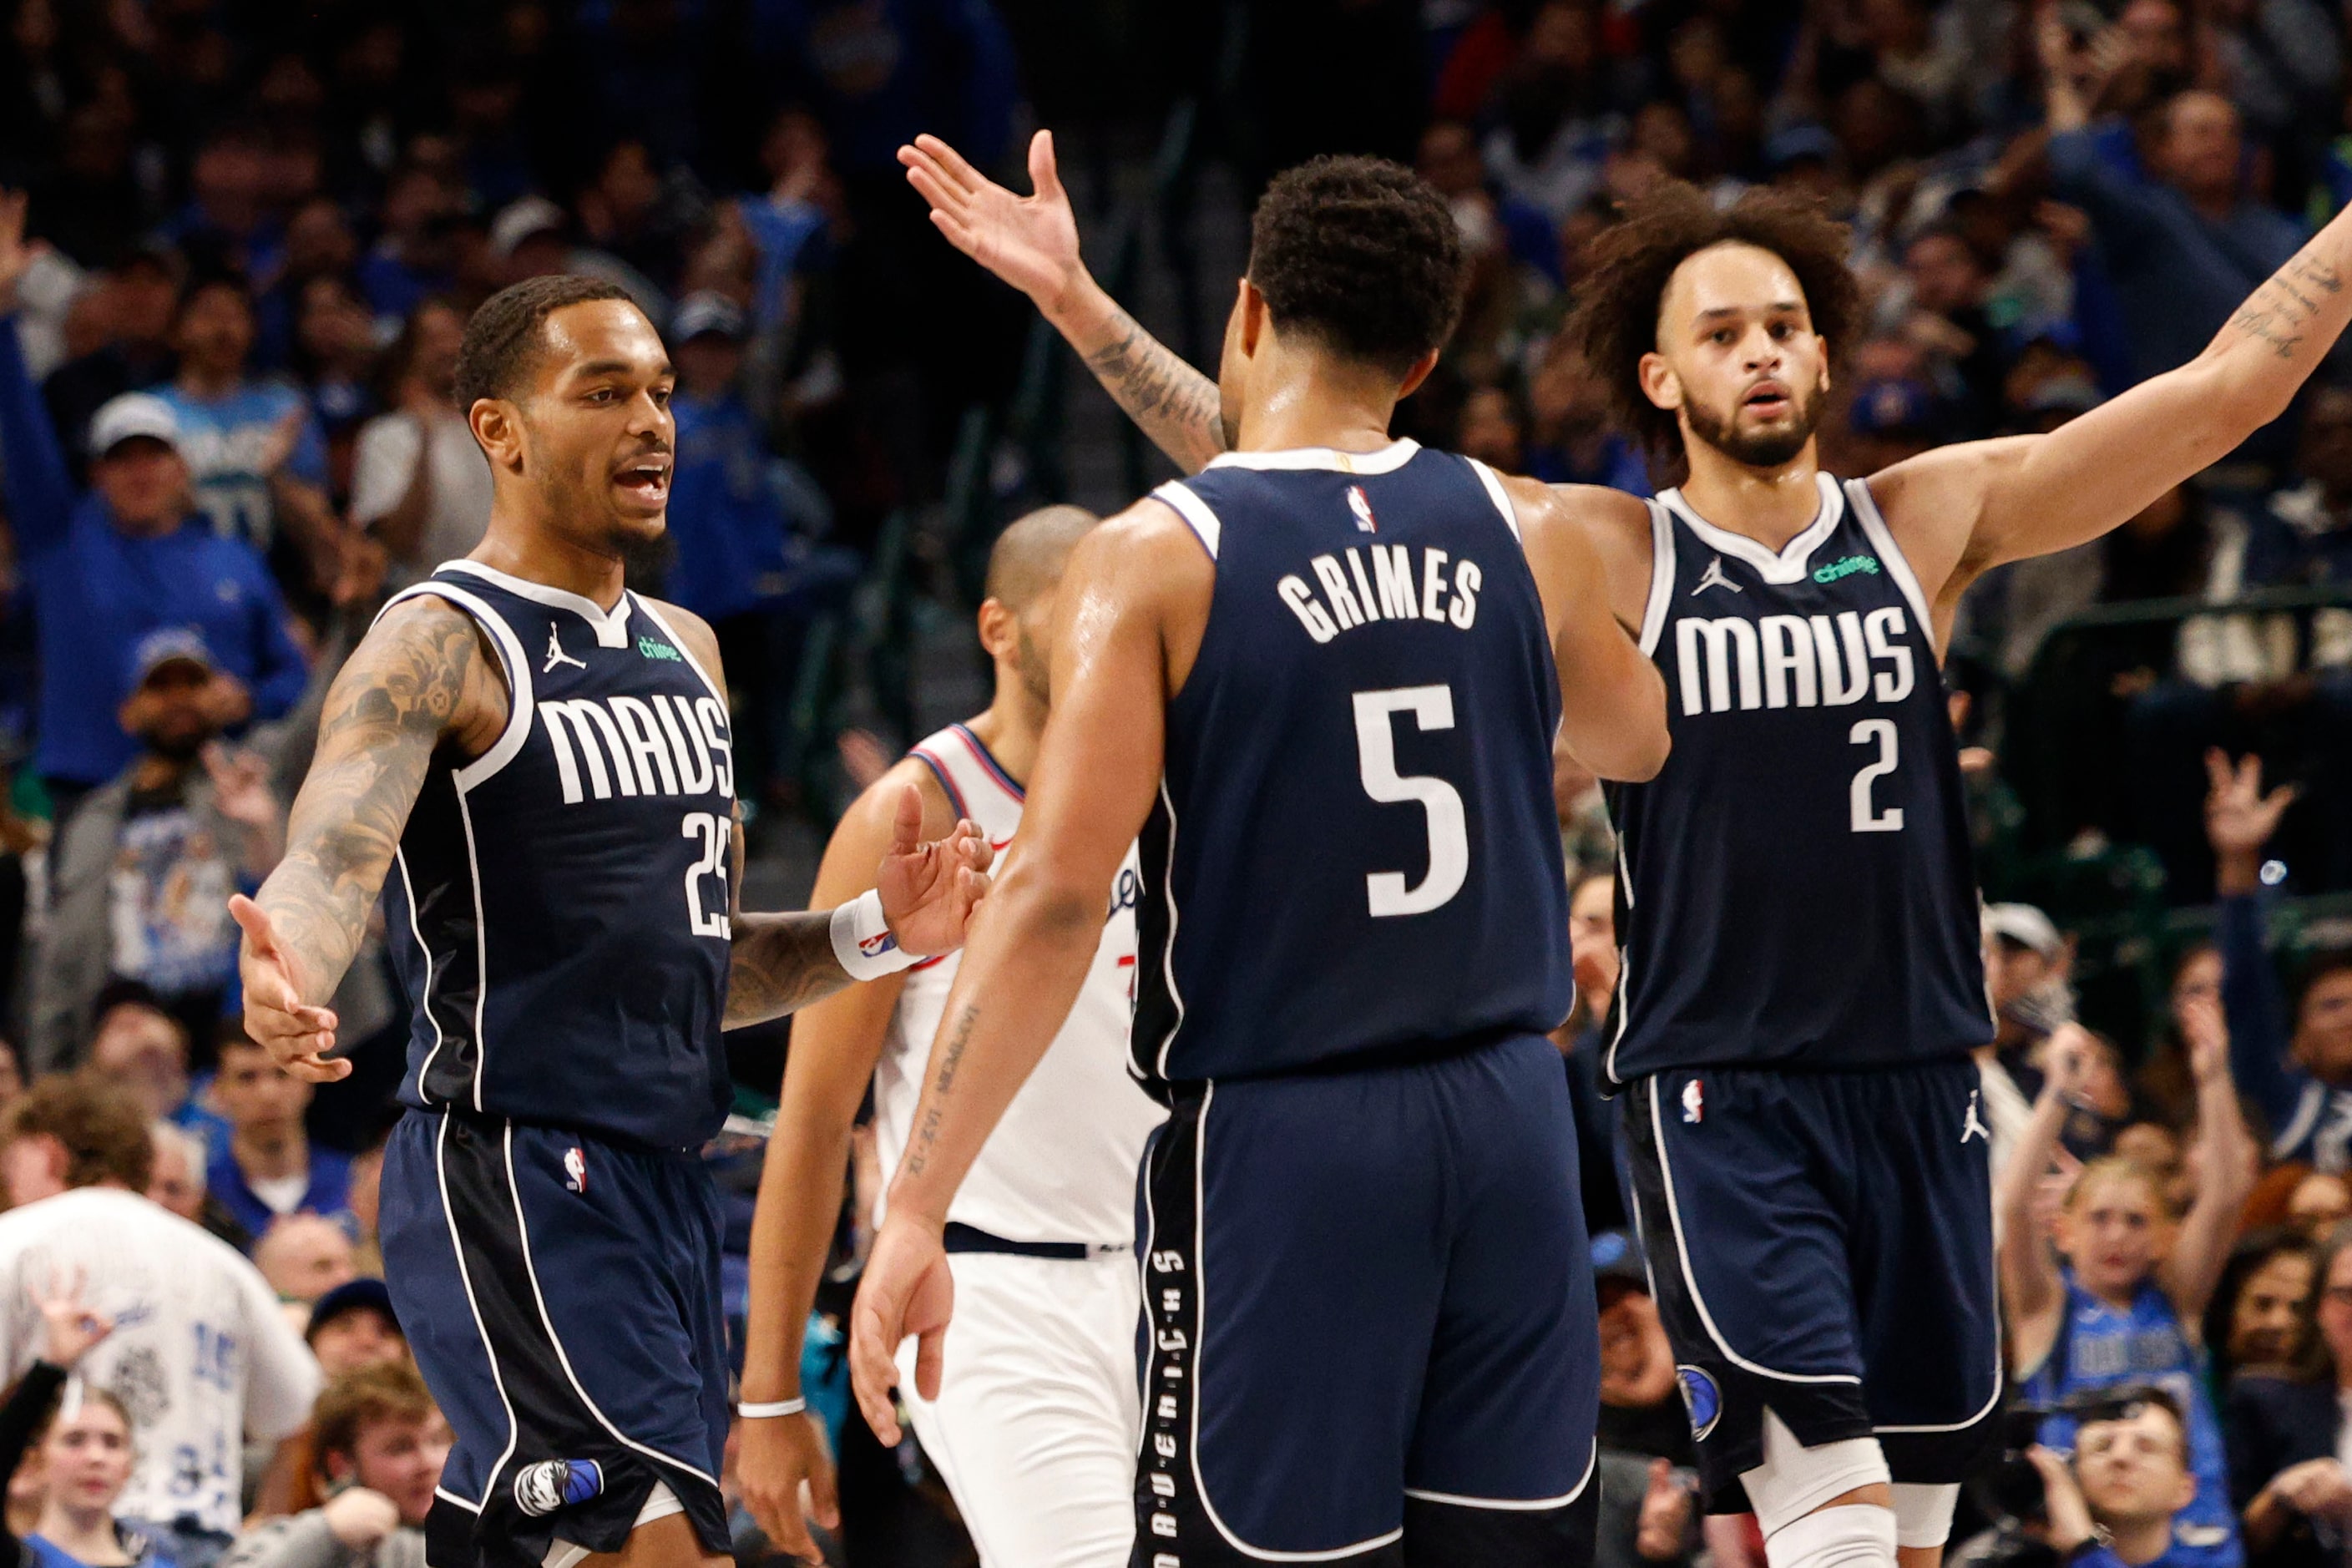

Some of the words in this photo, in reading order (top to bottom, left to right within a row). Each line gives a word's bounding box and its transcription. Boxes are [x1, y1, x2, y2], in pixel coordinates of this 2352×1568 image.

[1277, 544, 1483, 645] GRIMES
[1676, 606, 1915, 716] MAVS
[537, 695, 734, 804] MAVS
[1351, 683, 1469, 918] 5
[1849, 718, 1904, 832] 2
